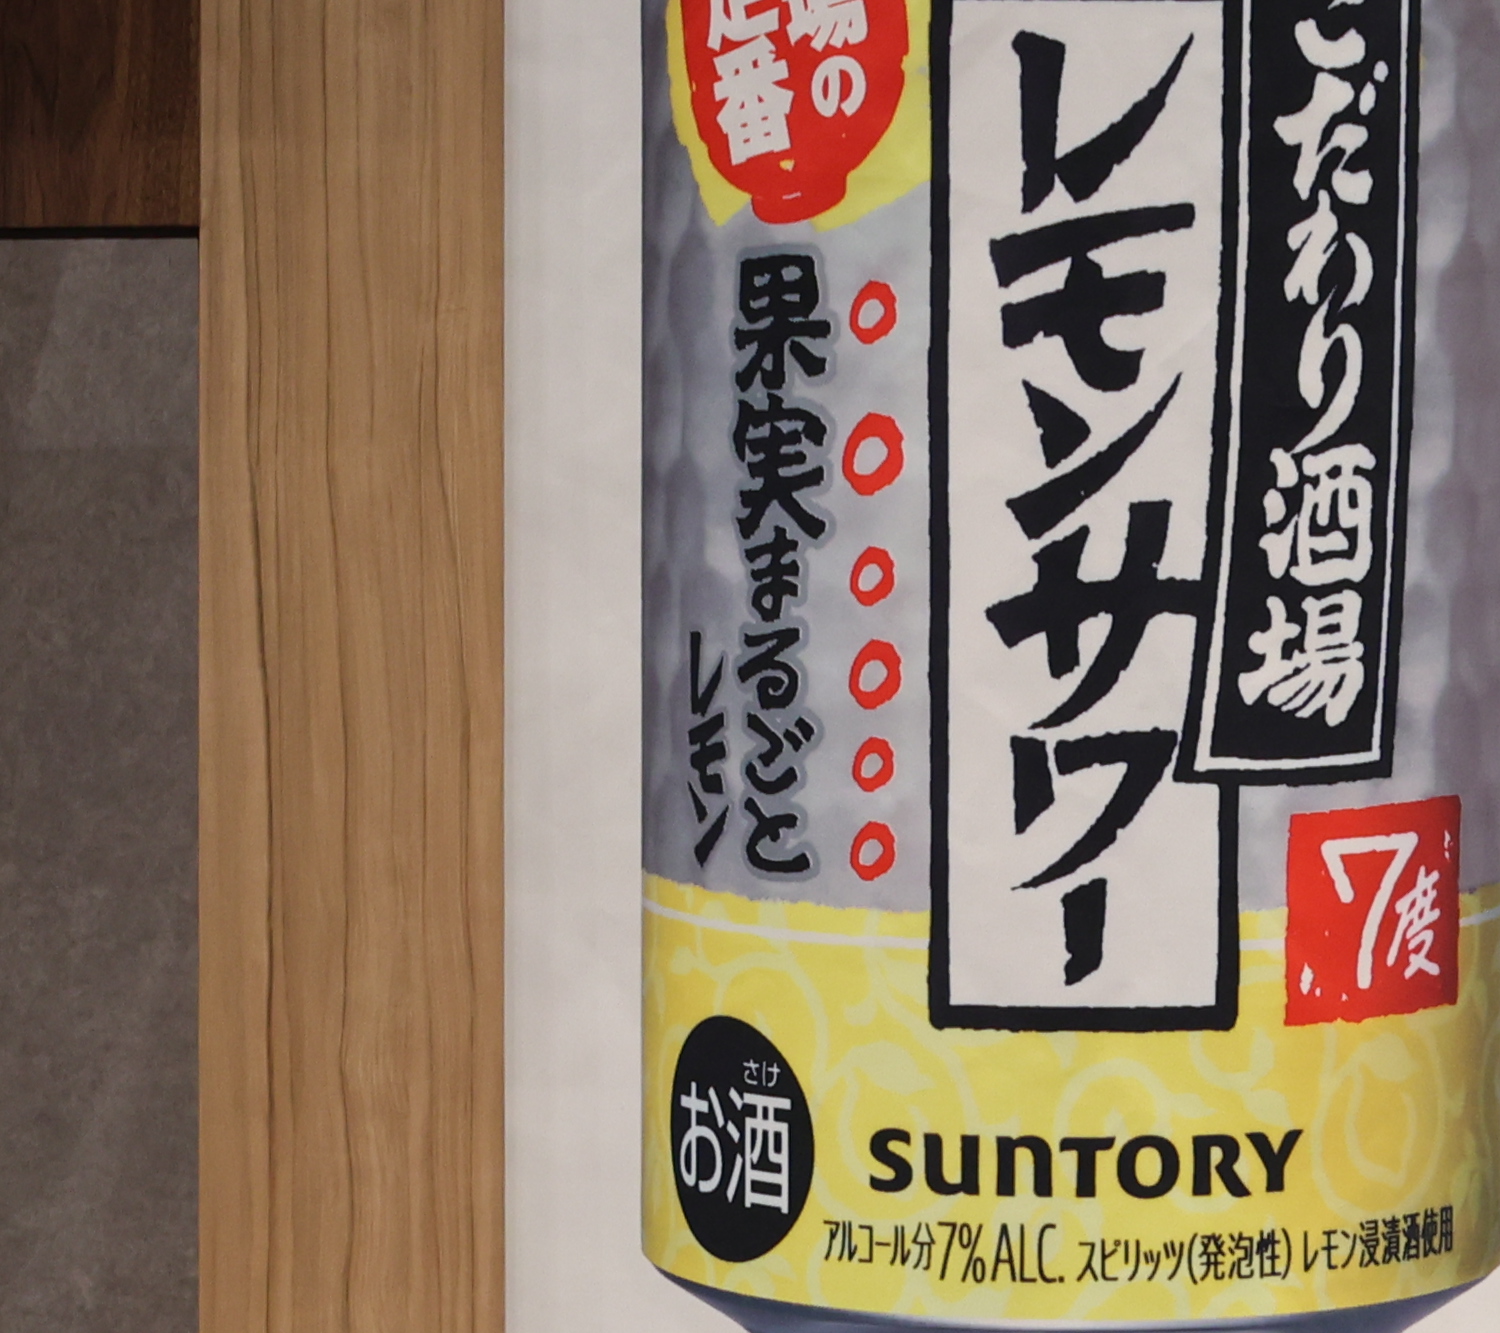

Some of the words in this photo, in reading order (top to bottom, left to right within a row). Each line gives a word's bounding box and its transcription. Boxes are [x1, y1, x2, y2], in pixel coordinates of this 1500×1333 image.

[1237, 0, 1389, 728] こだわり酒場
[730, 253, 832, 876] 果実まるごと
[984, 32, 1205, 986] レモンサワー
[686, 630, 728, 868] レモン
[1318, 830, 1444, 990] 7度
[678, 1085, 794, 1216] お酒
[743, 1058, 781, 1087] さけ
[868, 1128, 1304, 1199] SUNTORY
[1075, 1228, 1293, 1286] スピリッツ(発泡性)
